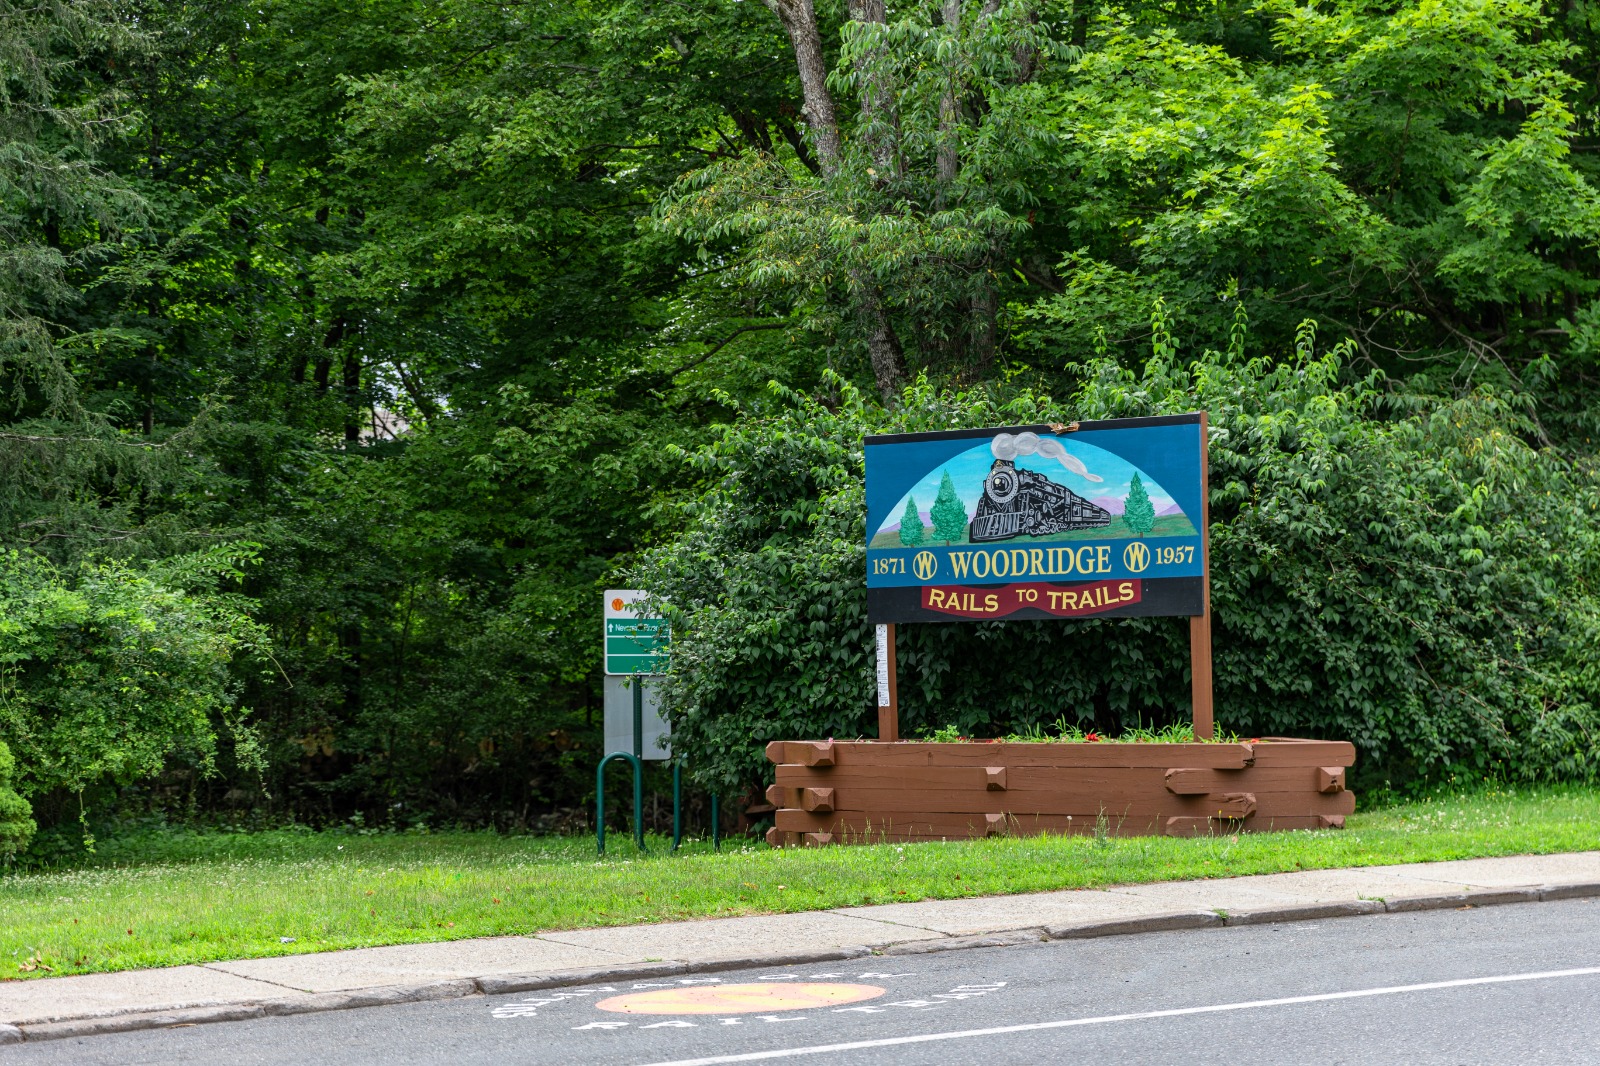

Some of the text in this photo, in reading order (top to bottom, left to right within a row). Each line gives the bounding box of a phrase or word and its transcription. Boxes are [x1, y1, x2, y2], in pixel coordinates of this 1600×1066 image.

[872, 557, 906, 575] 1871
[948, 546, 1112, 578] WOODRIDGE
[1155, 546, 1195, 565] 1957
[928, 582, 1135, 613] RAILS TO TRAILS
[491, 978, 722, 1018] SULLIVAN
[571, 981, 1007, 1030] RAIL TRAIL
